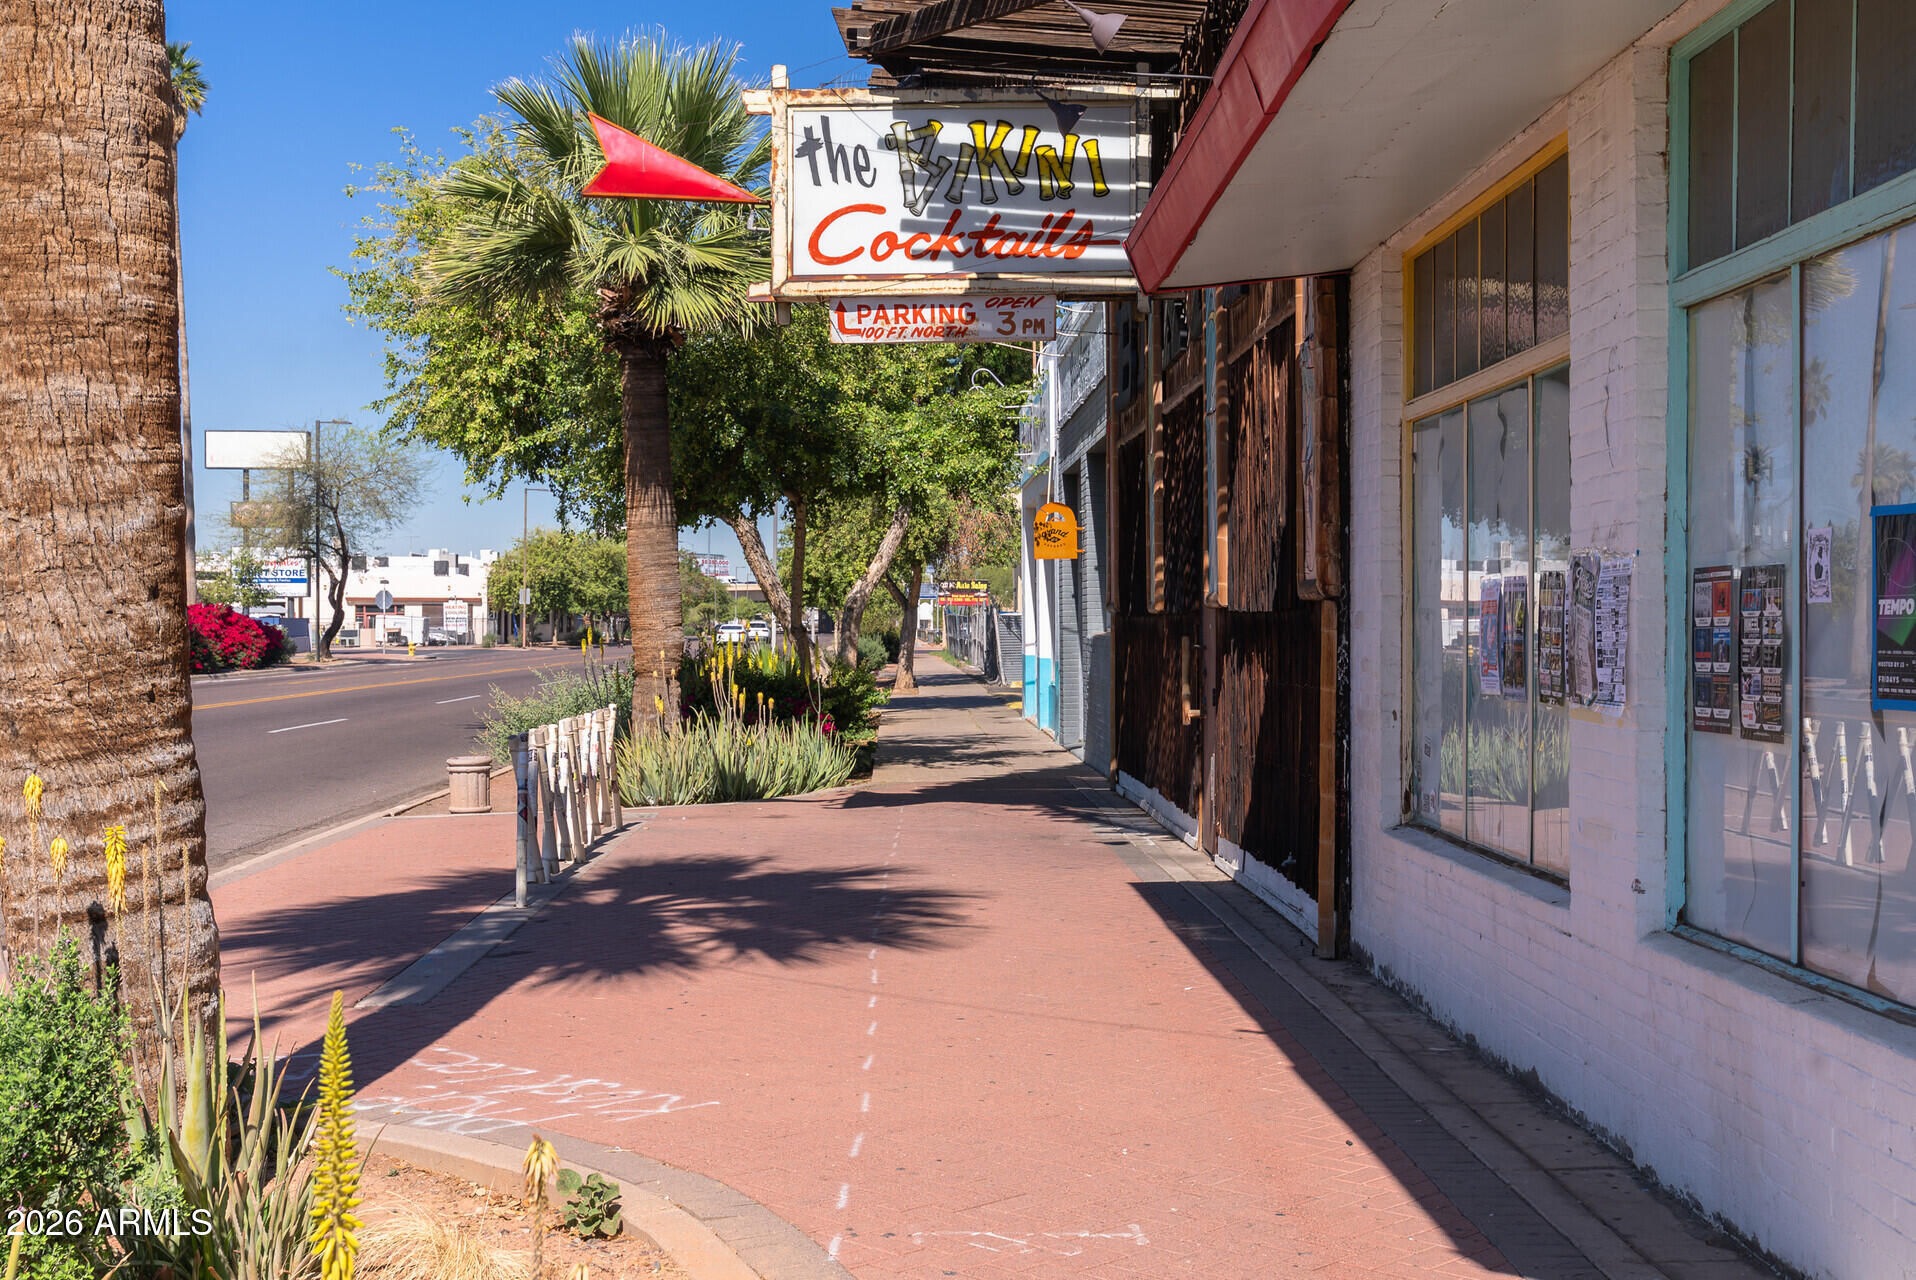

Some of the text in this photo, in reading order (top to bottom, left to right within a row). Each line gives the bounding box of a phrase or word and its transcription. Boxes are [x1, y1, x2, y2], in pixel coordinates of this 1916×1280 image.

[795, 115, 877, 188] the
[808, 203, 1121, 266] Cocktails
[985, 296, 1044, 309] OPEN
[857, 303, 976, 325] PARKING
[860, 326, 968, 339] 100 FT. NORTH
[996, 312, 1046, 336] 3 PM
[272, 569, 306, 577] STORE
[1878, 598, 1915, 615] TEMPO
[1878, 675, 1900, 684] FRIDAYS
